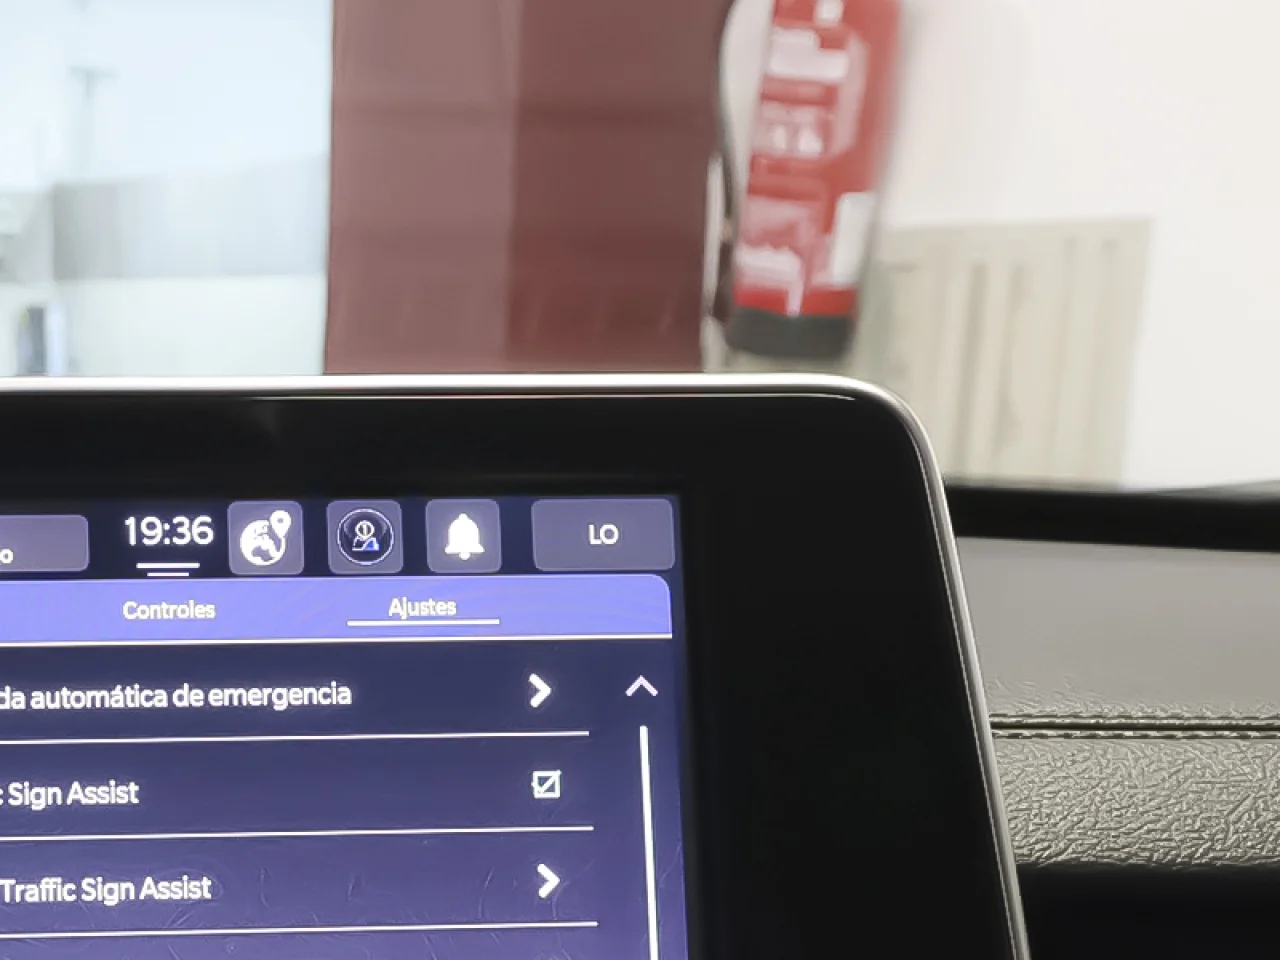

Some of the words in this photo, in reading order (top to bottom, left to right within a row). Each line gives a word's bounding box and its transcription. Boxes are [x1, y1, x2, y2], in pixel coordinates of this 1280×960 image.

[124, 515, 213, 545] 19:36
[588, 524, 618, 544] LO
[122, 599, 216, 619] Controles
[388, 596, 456, 618] Ajustes
[29, 683, 168, 709] automática
[172, 682, 204, 707] de
[207, 680, 352, 710] emergencia
[7, 780, 62, 810] Sign
[66, 779, 139, 805] Assist
[81, 876, 135, 906] Sign
[138, 874, 211, 899] Assist
